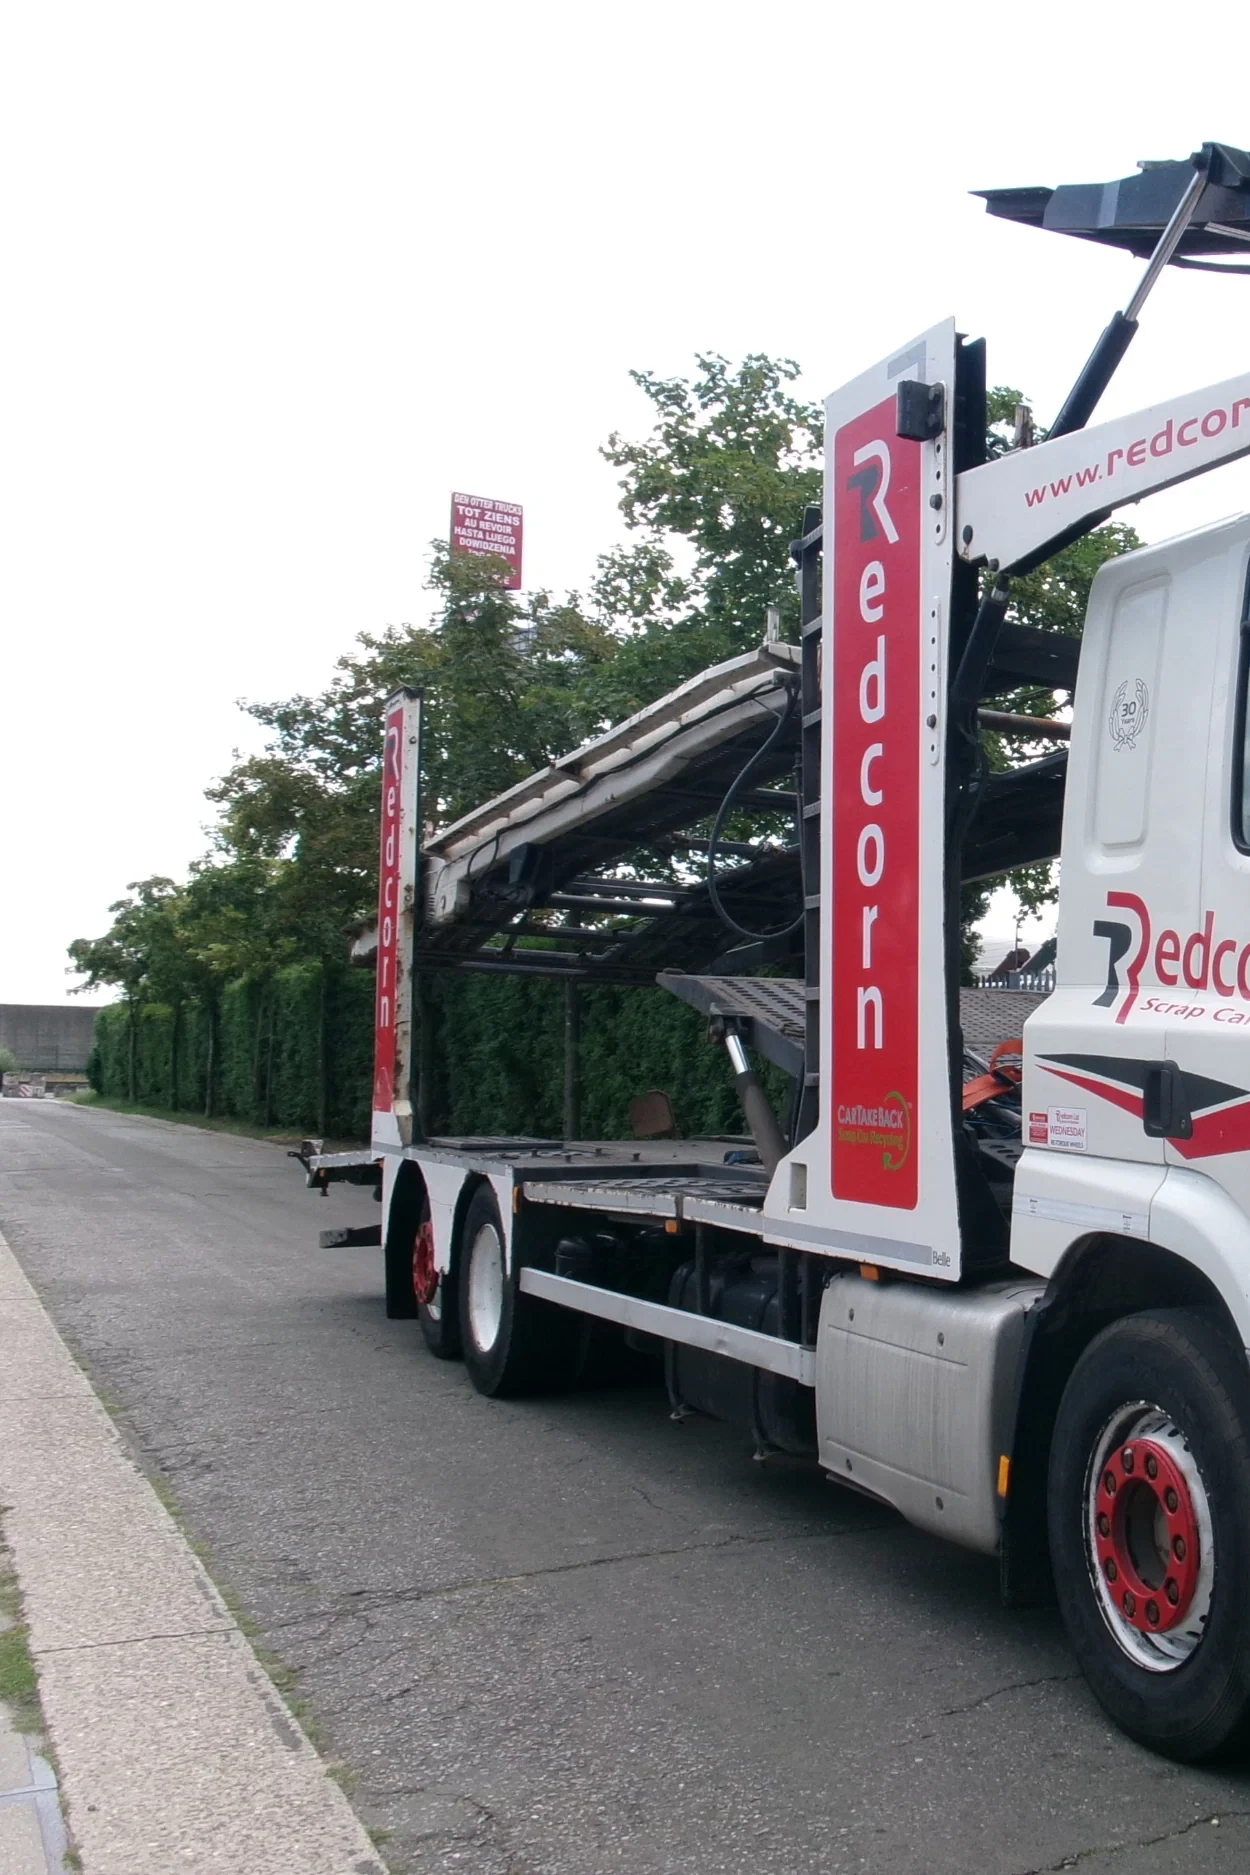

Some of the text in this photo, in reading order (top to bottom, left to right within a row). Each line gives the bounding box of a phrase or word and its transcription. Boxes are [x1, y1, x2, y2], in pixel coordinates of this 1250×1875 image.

[454, 494, 522, 515] DEN OTTER TRUCKS
[456, 505, 520, 526] TOT ZIENS
[454, 526, 516, 545] HASTA LUEGO
[464, 518, 512, 535] AU REVOIR
[459, 537, 516, 555] DOWIDZENIA
[1121, 701, 1136, 718] 30
[847, 439, 900, 1050] Redcorn
[1140, 997, 1205, 1020] Scrap
[1050, 1125, 1085, 1137] WEDNESDAY
[932, 1251, 952, 1268] Belle
